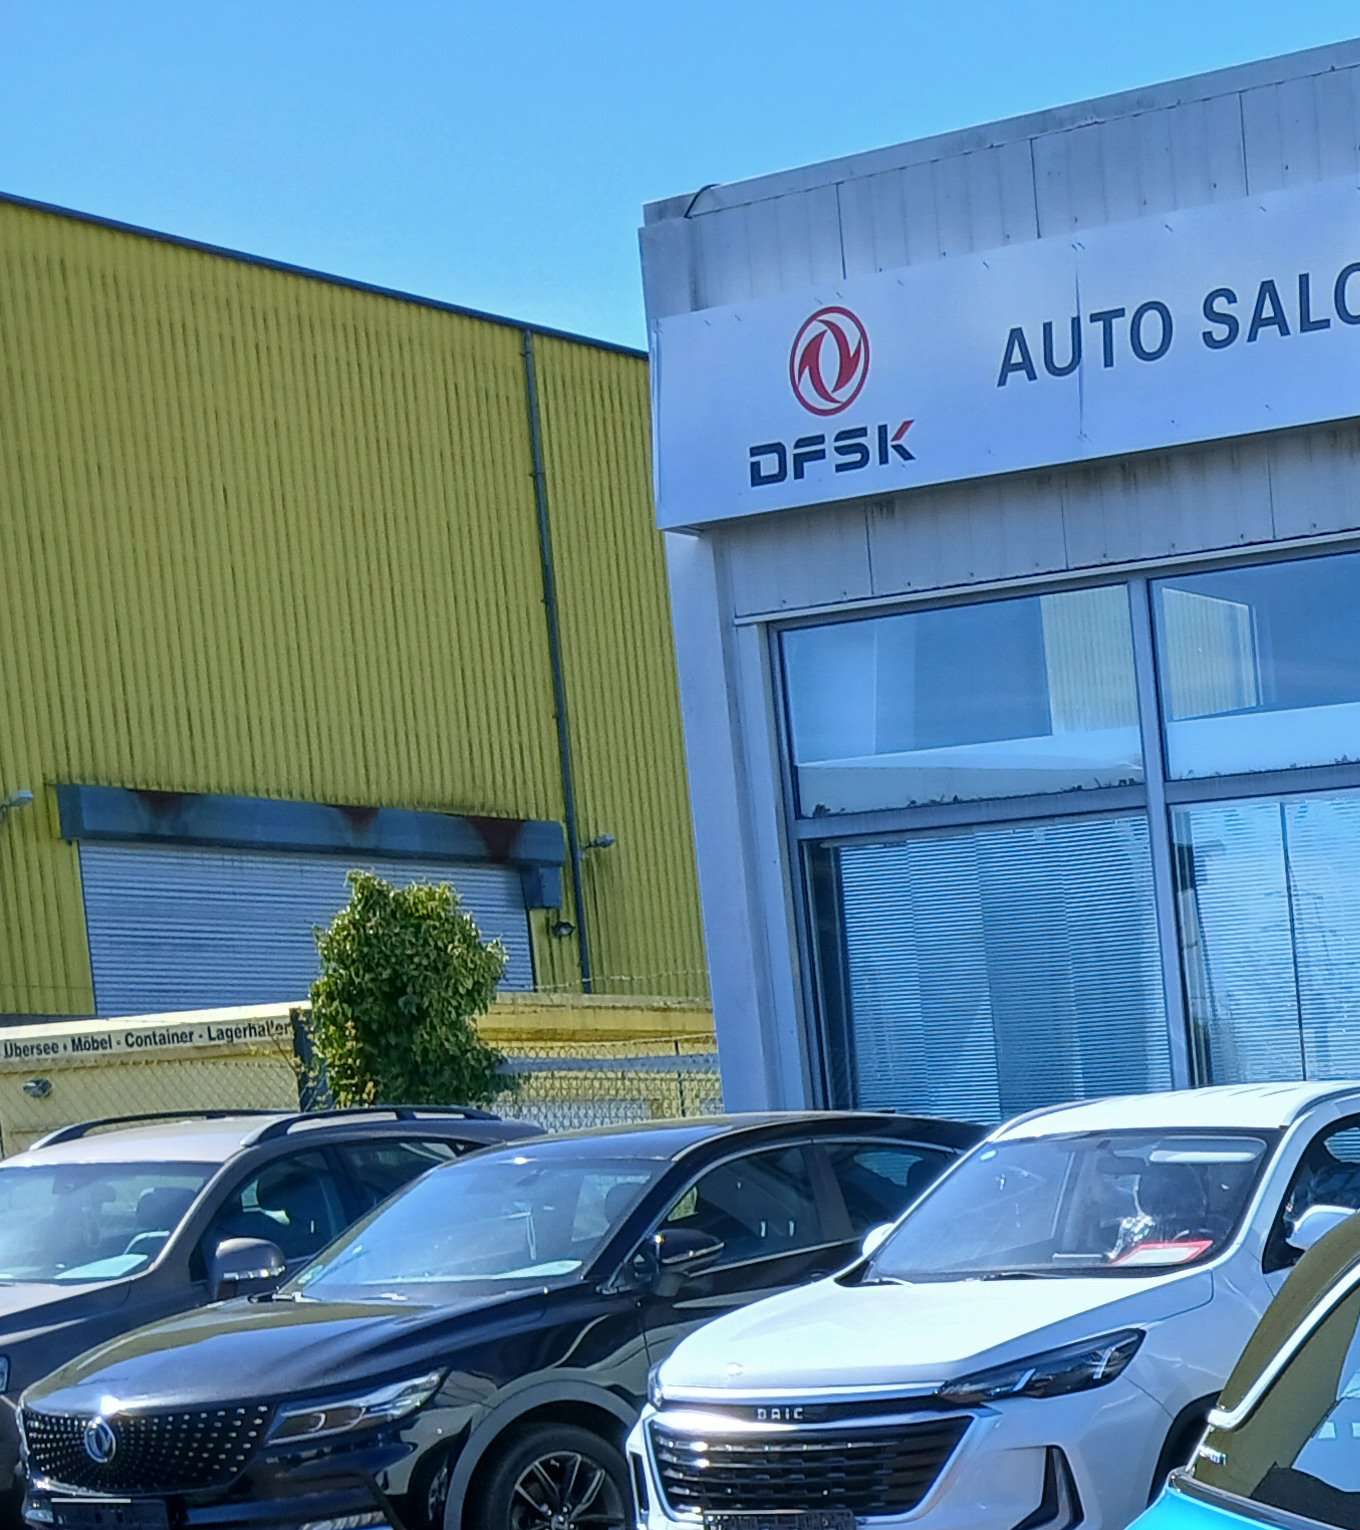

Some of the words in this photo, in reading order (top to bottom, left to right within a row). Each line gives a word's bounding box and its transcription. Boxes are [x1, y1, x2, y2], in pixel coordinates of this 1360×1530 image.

[996, 300, 1174, 388] AUTO
[748, 419, 917, 488] DFSK
[3, 1038, 60, 1059] Übersee
[71, 1034, 113, 1053] Möbel
[124, 1030, 195, 1049] Container
